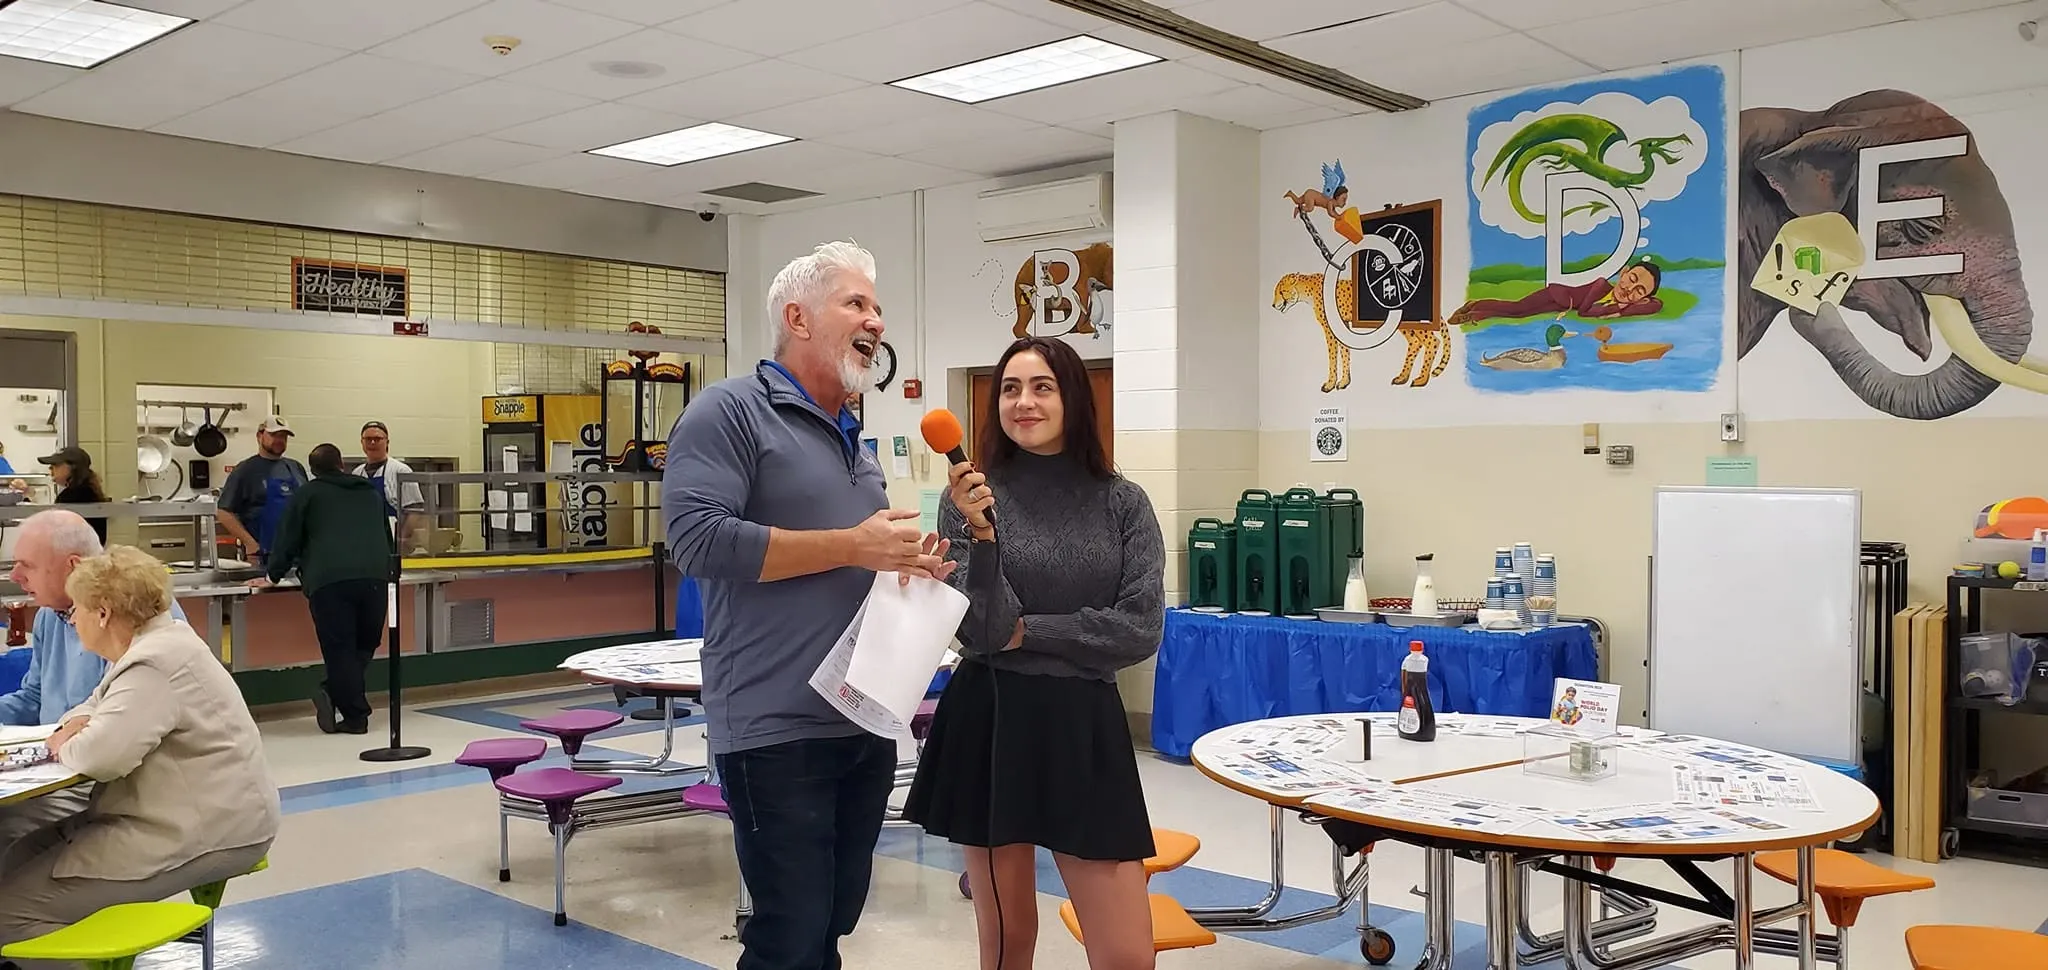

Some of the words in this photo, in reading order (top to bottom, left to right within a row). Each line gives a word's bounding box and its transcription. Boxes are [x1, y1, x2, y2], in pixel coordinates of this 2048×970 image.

[1544, 170, 1641, 288] D
[1855, 133, 1969, 281] E
[304, 272, 398, 308] Healthy
[1033, 247, 1081, 338] B
[1322, 233, 1404, 351] C
[494, 400, 525, 418] Snapple
